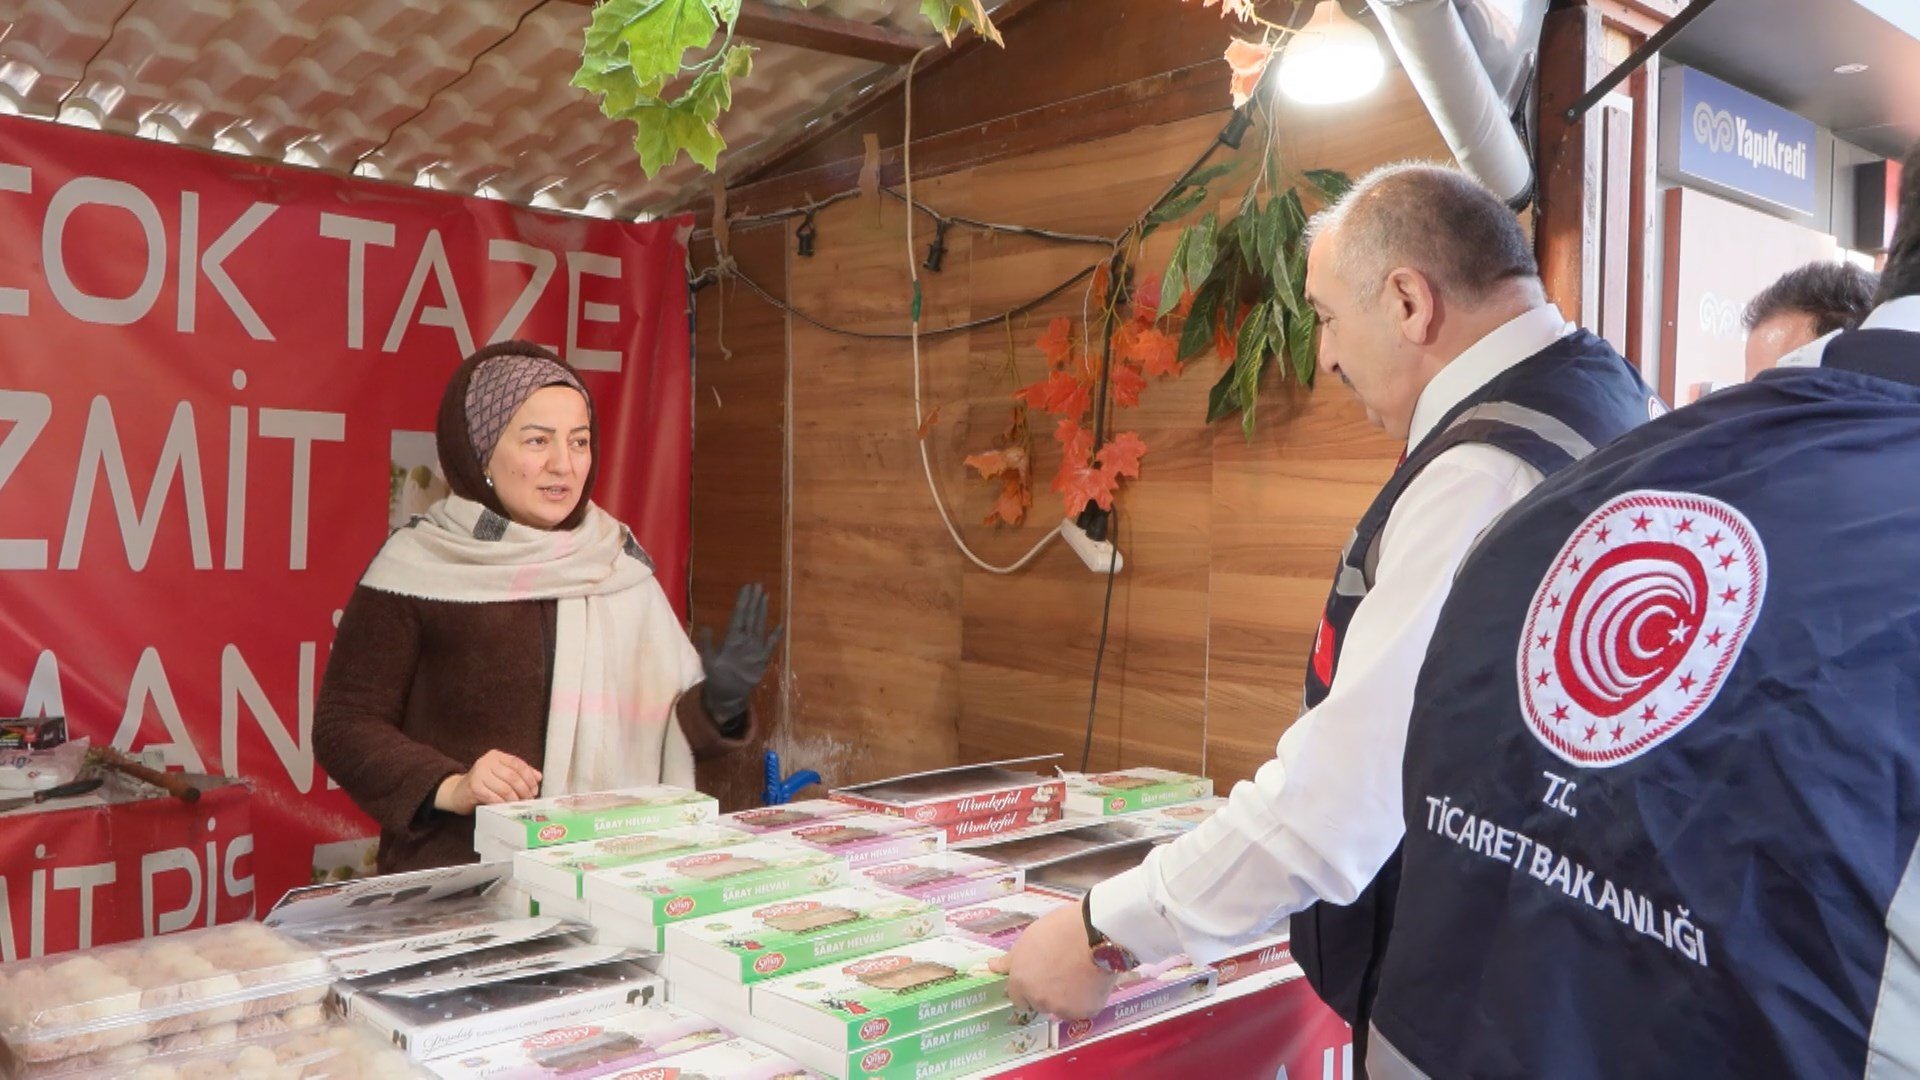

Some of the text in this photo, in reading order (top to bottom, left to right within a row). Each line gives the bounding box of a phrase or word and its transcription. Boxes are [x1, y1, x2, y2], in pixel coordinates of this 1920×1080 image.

[319, 212, 623, 373] TAZE
[957, 790, 1022, 813] Wonderful
[1542, 770, 1578, 818] T.C.
[594, 819, 625, 833] SARAY
[955, 811, 1018, 836] Wonderful
[722, 879, 791, 903] SARAY HELVASI
[1425, 795, 1709, 967] TİCARET BAKANLIĞI
[0, 844, 116, 962] İT
[814, 930, 885, 958] SARAY HELVASI
[918, 991, 987, 1021] SARAY HELVASI
[1115, 1002, 1140, 1020] SARAY
[920, 1021, 991, 1051] SARAY HELVASI
[915, 1049, 987, 1080] SARAY HELVASI
